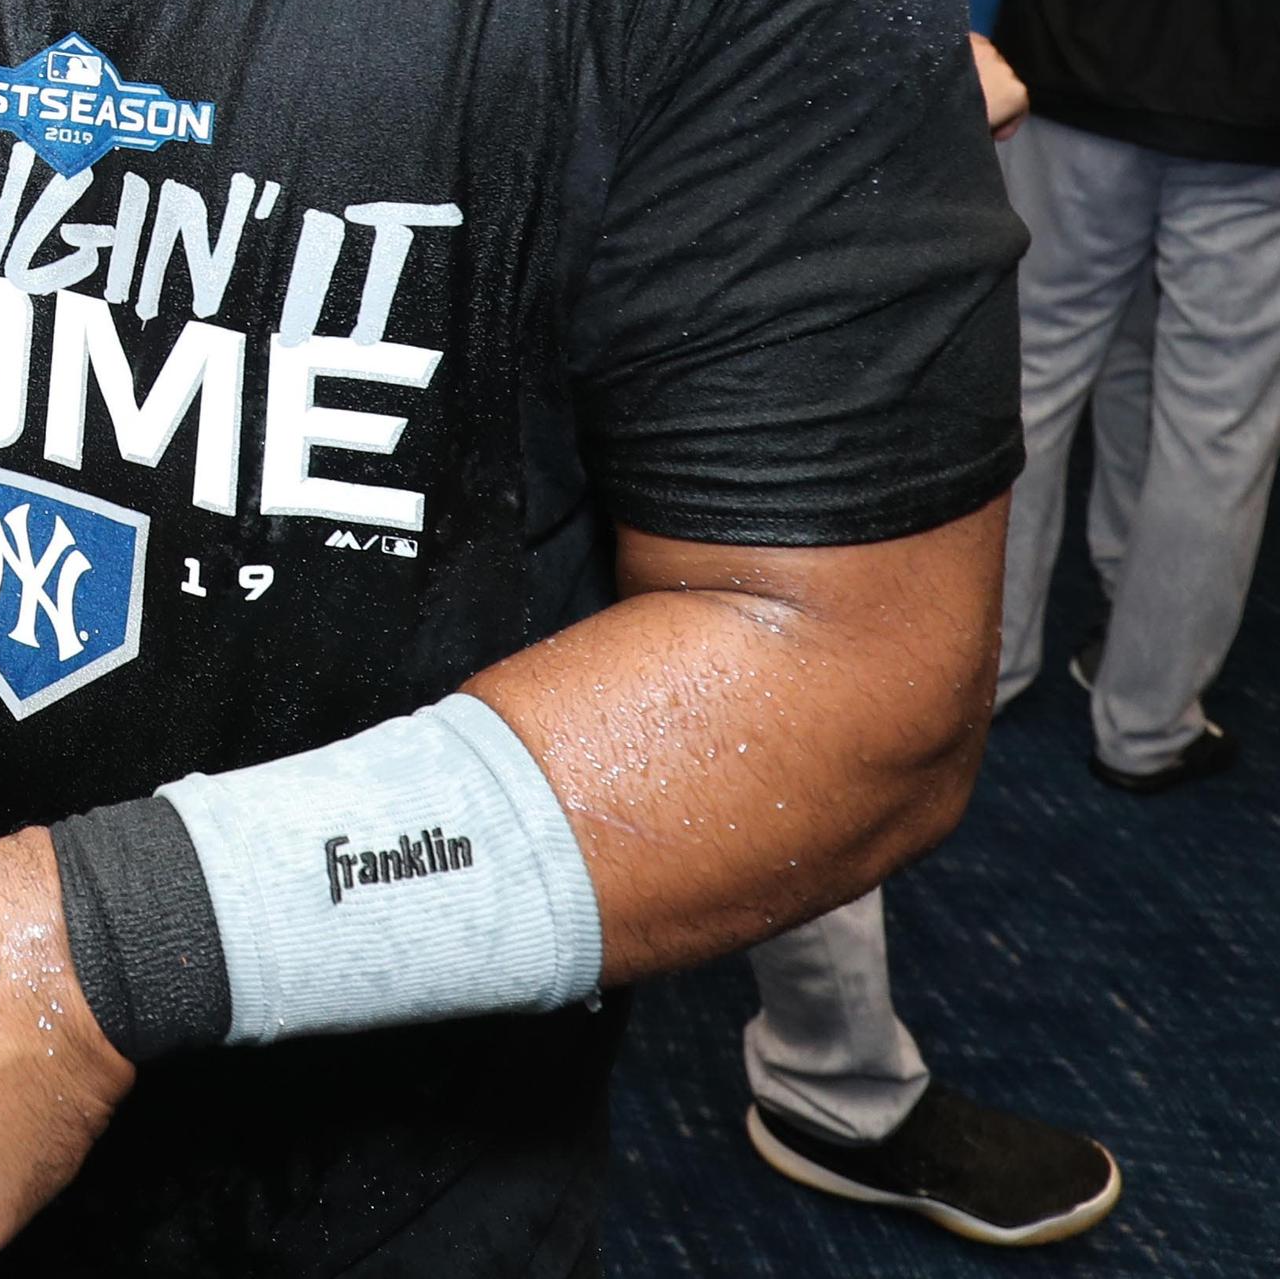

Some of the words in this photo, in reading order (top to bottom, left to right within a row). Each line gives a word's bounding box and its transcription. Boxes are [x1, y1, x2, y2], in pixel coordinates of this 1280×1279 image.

[44, 126, 94, 146] 2019
[277, 202, 464, 347] IT
[324, 826, 474, 905] Franklin
